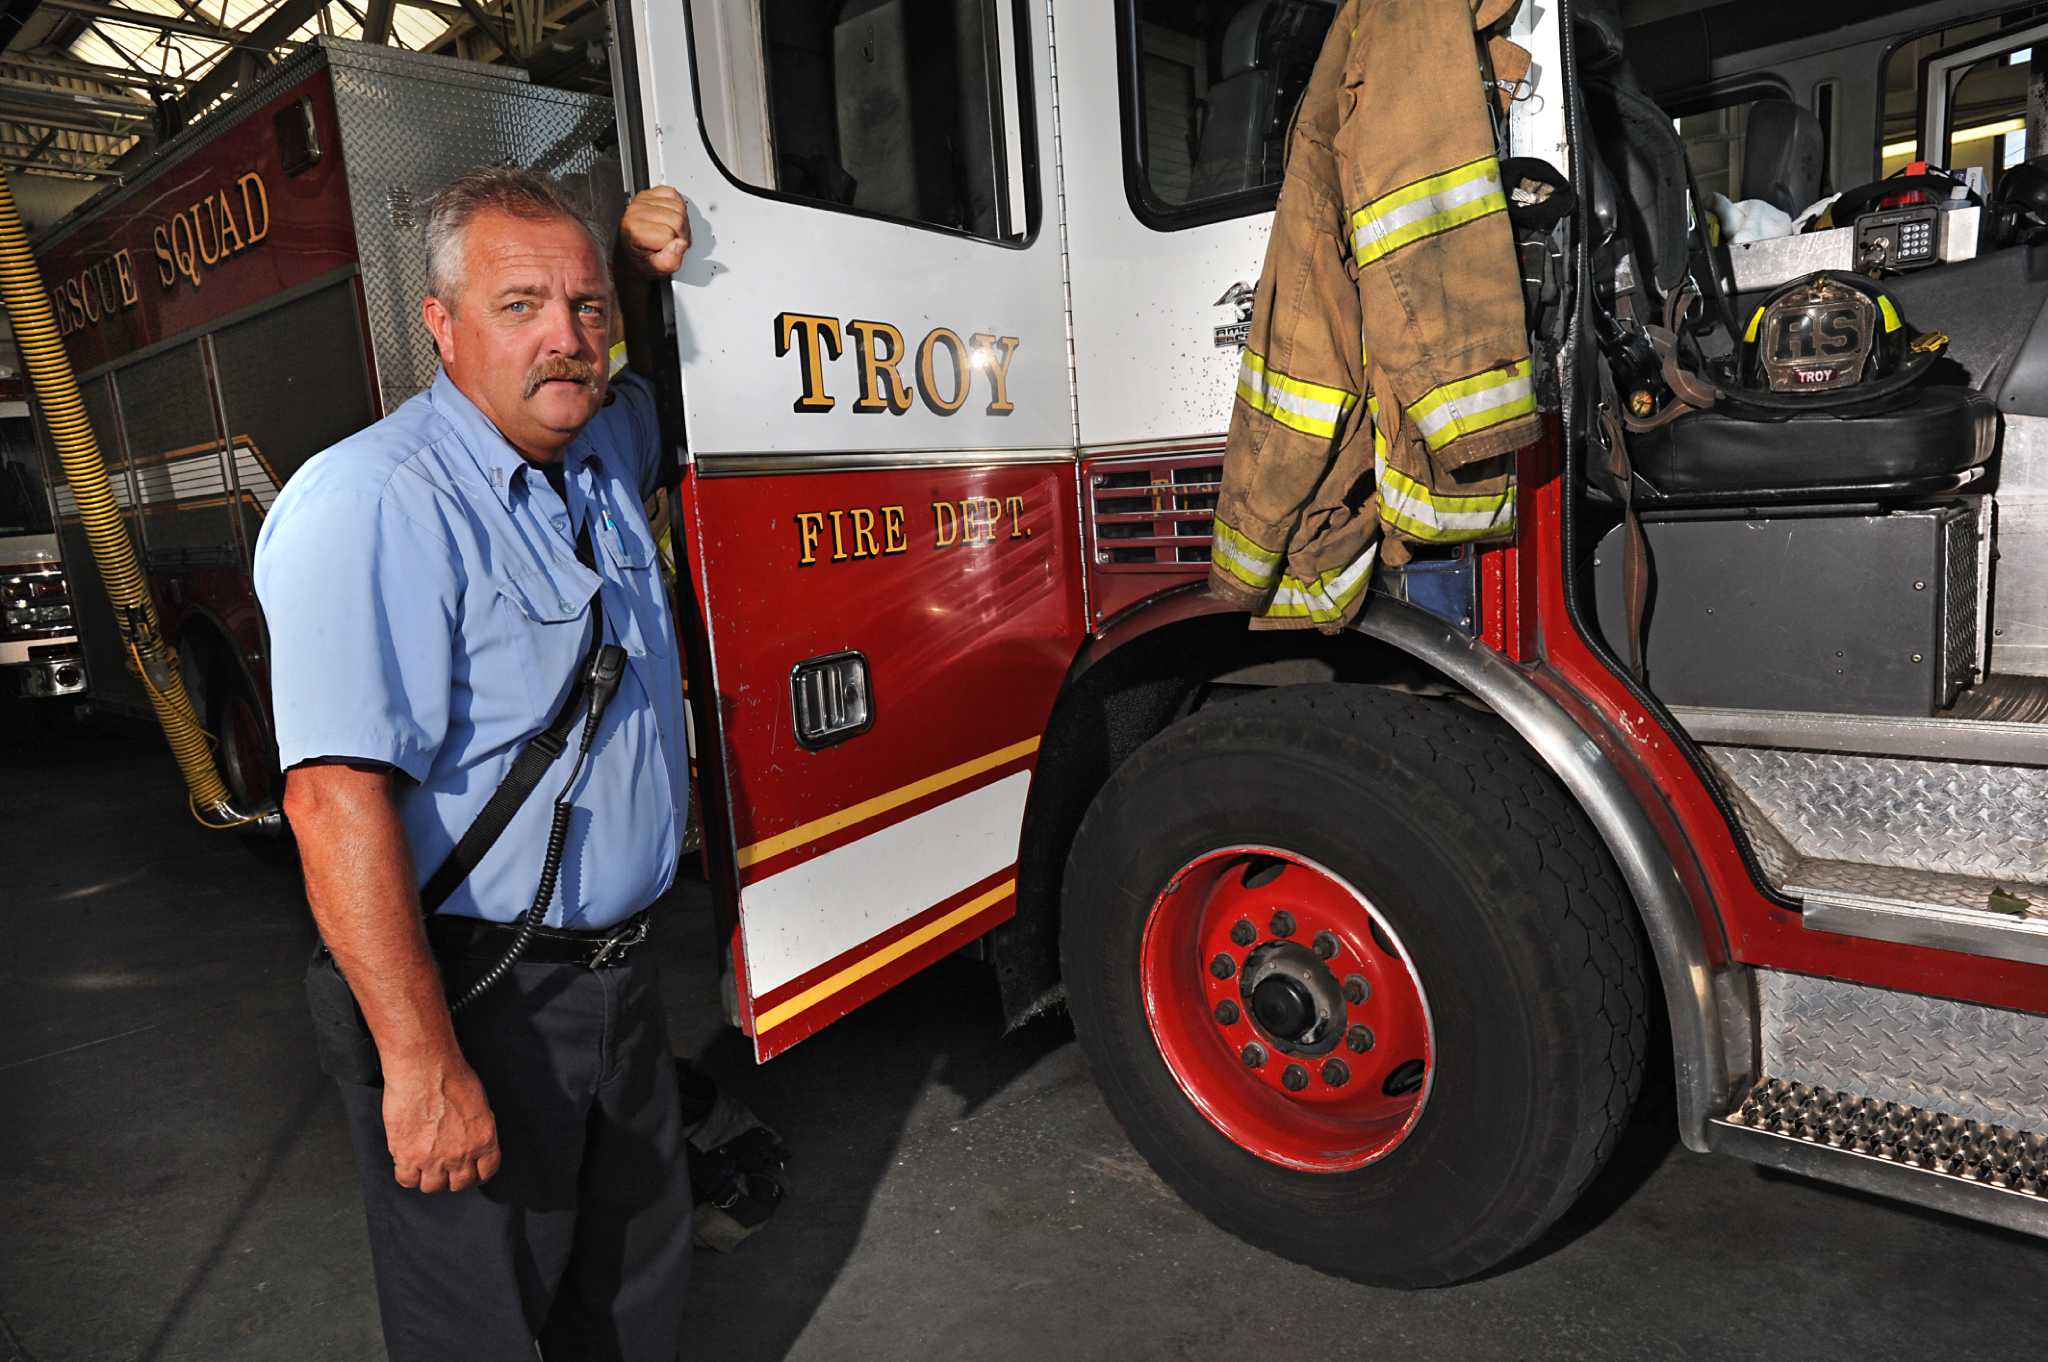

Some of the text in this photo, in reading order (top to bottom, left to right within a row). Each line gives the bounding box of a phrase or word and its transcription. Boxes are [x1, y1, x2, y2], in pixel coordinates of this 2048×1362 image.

[50, 171, 270, 336] ESCUE SQUAD
[773, 311, 1020, 417] TROY
[1798, 369, 1833, 383] TROY
[796, 496, 1033, 567] FIRE DEPT.
